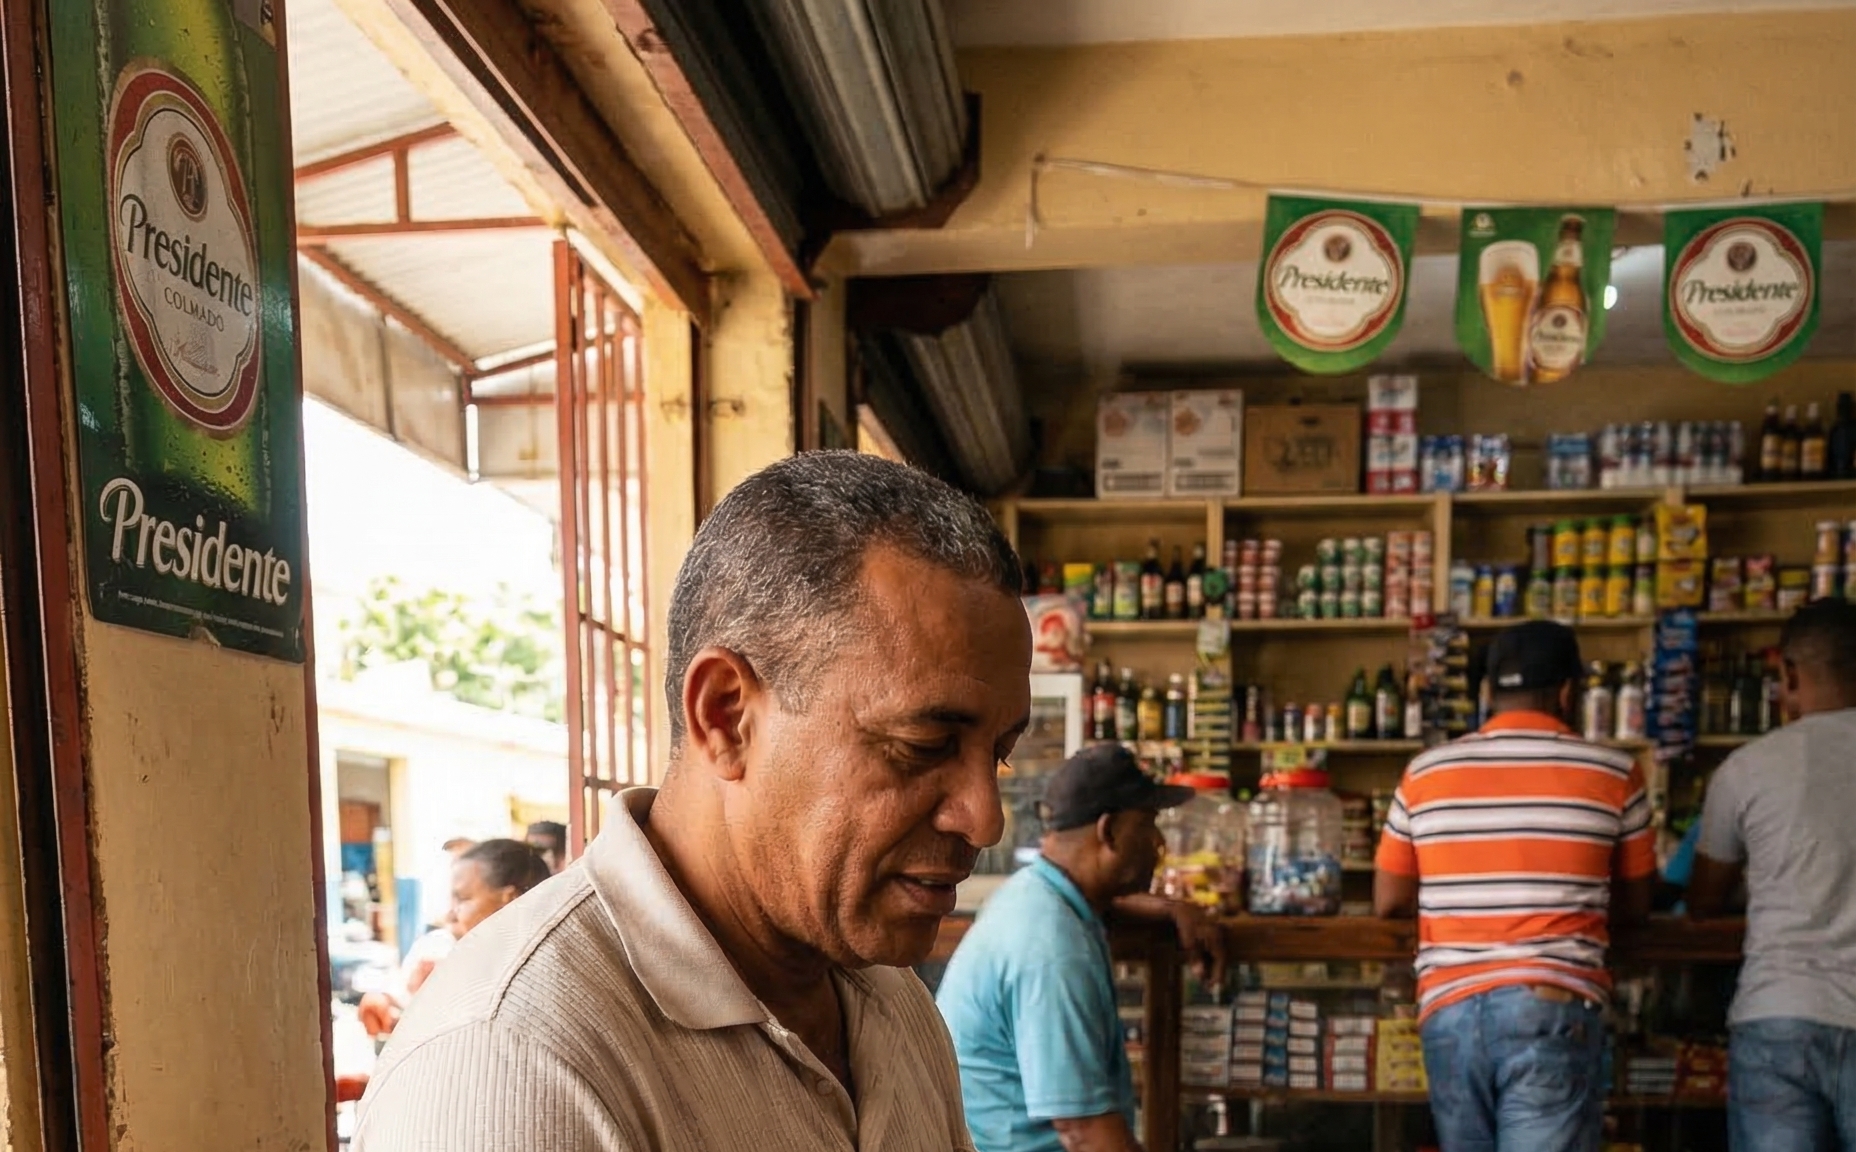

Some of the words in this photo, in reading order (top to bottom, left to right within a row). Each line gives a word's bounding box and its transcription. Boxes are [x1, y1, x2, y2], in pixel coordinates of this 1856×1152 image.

[119, 193, 253, 317] Presidente
[1279, 264, 1388, 295] Presidente
[1682, 279, 1799, 304] Presidente
[164, 286, 225, 333] COLMADO
[100, 477, 292, 606] Presidente
